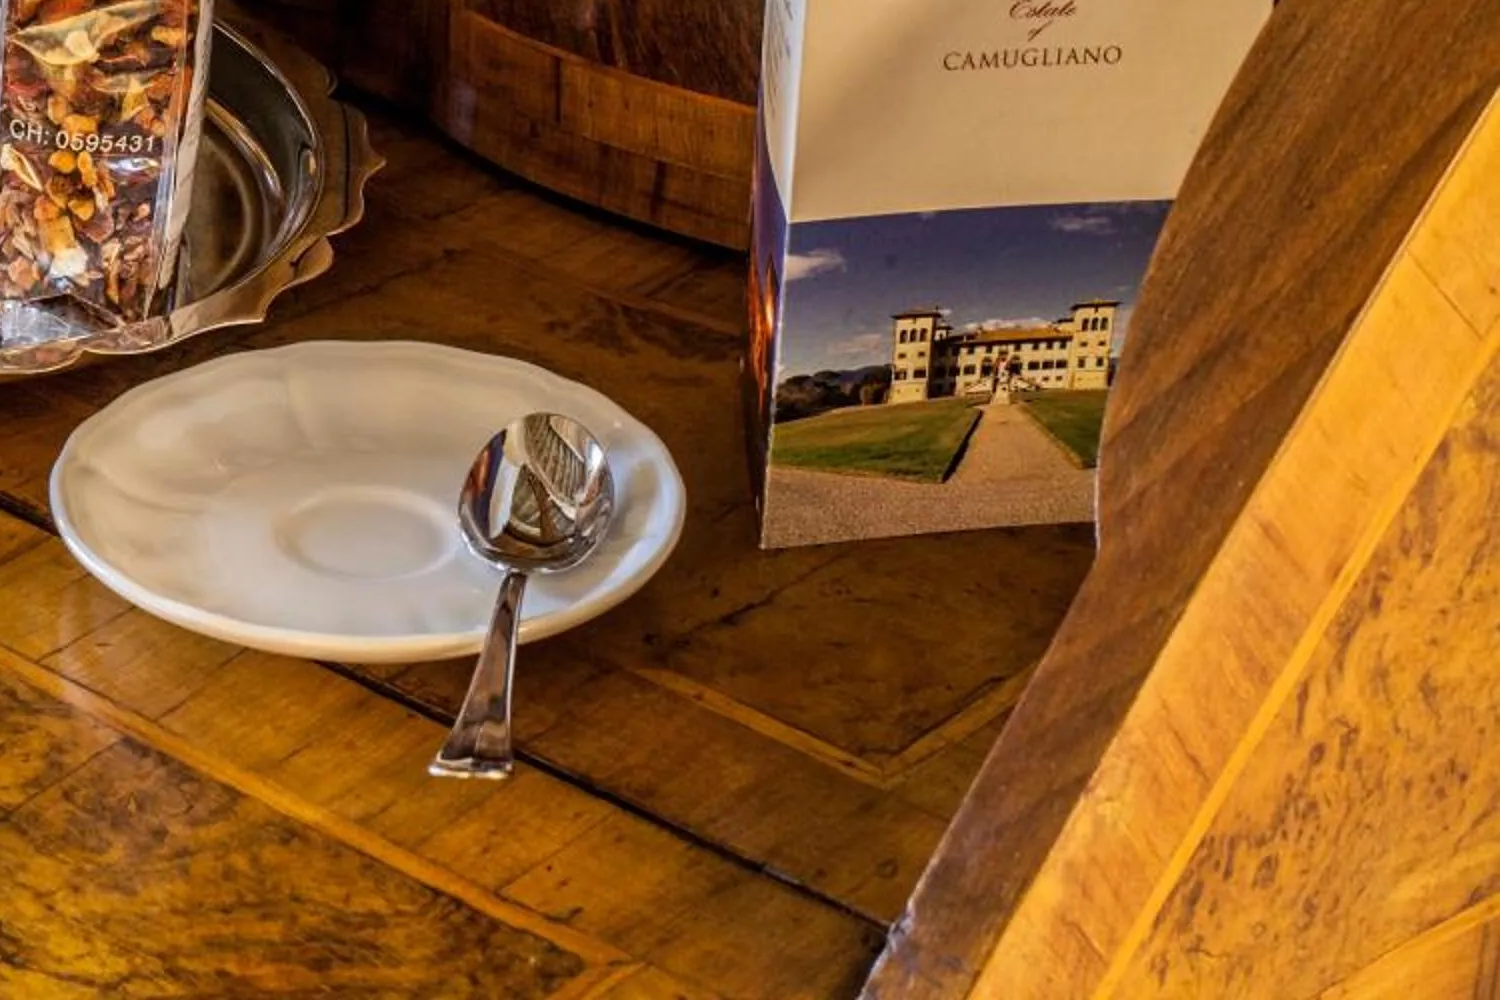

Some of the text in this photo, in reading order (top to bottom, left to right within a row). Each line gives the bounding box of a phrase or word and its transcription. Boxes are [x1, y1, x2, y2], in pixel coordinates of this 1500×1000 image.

[942, 44, 1123, 71] CAMUGLIANO
[8, 118, 156, 153] CH: 0595431
